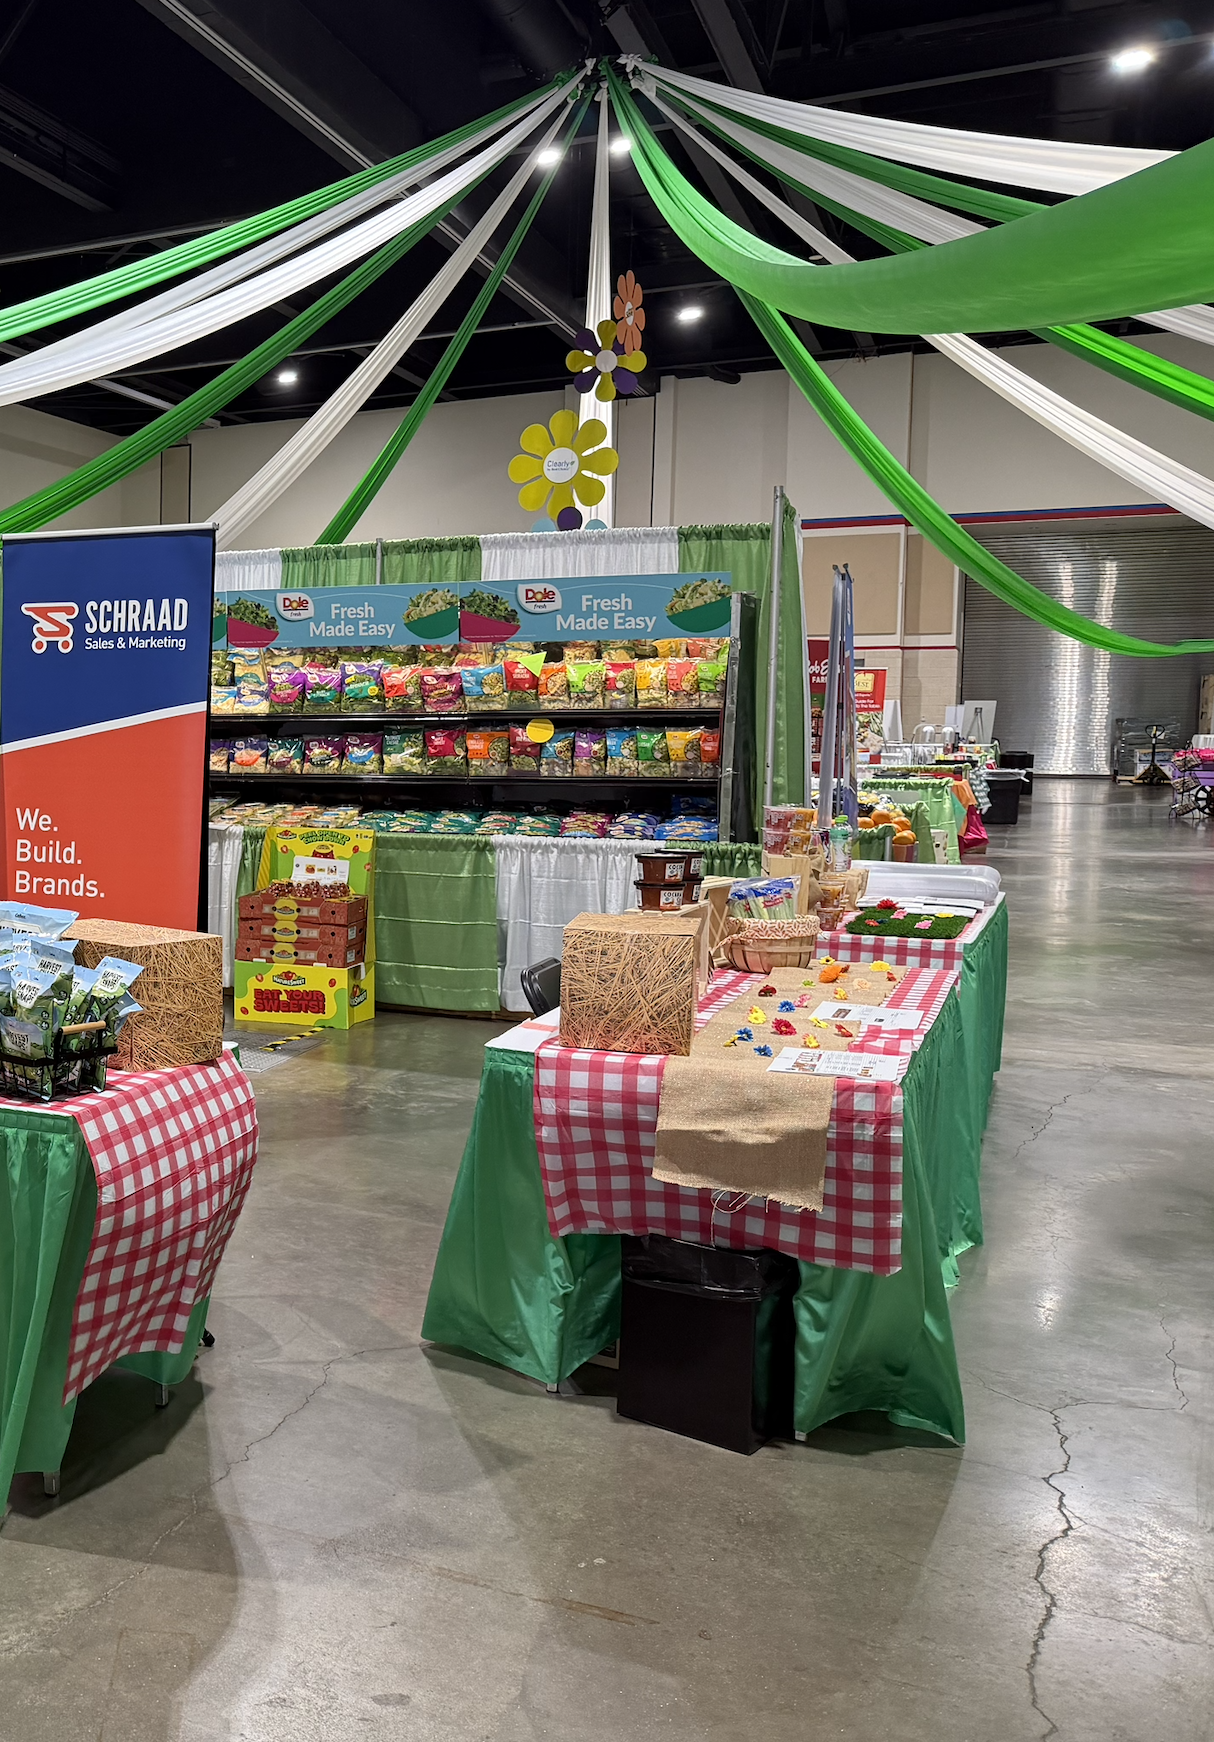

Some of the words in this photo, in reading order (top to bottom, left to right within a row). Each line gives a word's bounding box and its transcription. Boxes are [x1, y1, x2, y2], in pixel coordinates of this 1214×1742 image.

[283, 597, 309, 610] Dole
[526, 588, 556, 602] Dole
[581, 593, 633, 612] Fresh
[85, 598, 188, 634] SCHRAAD
[331, 602, 375, 619] Fresh
[309, 620, 355, 638] Made
[358, 620, 396, 638] Easy
[556, 614, 608, 631] Made
[614, 613, 657, 632] Easy
[85, 638, 115, 650] Sales
[117, 638, 126, 649] &
[128, 636, 186, 651] Marketing
[16, 808, 58, 831] We.
[16, 840, 82, 864] Build.
[15, 870, 105, 898] Brands.
[38, 959, 62, 974] HARVEST
[254, 988, 282, 1000] EAT
[284, 989, 325, 1001] YOUR
[254, 1000, 326, 1014] SWEETS!
